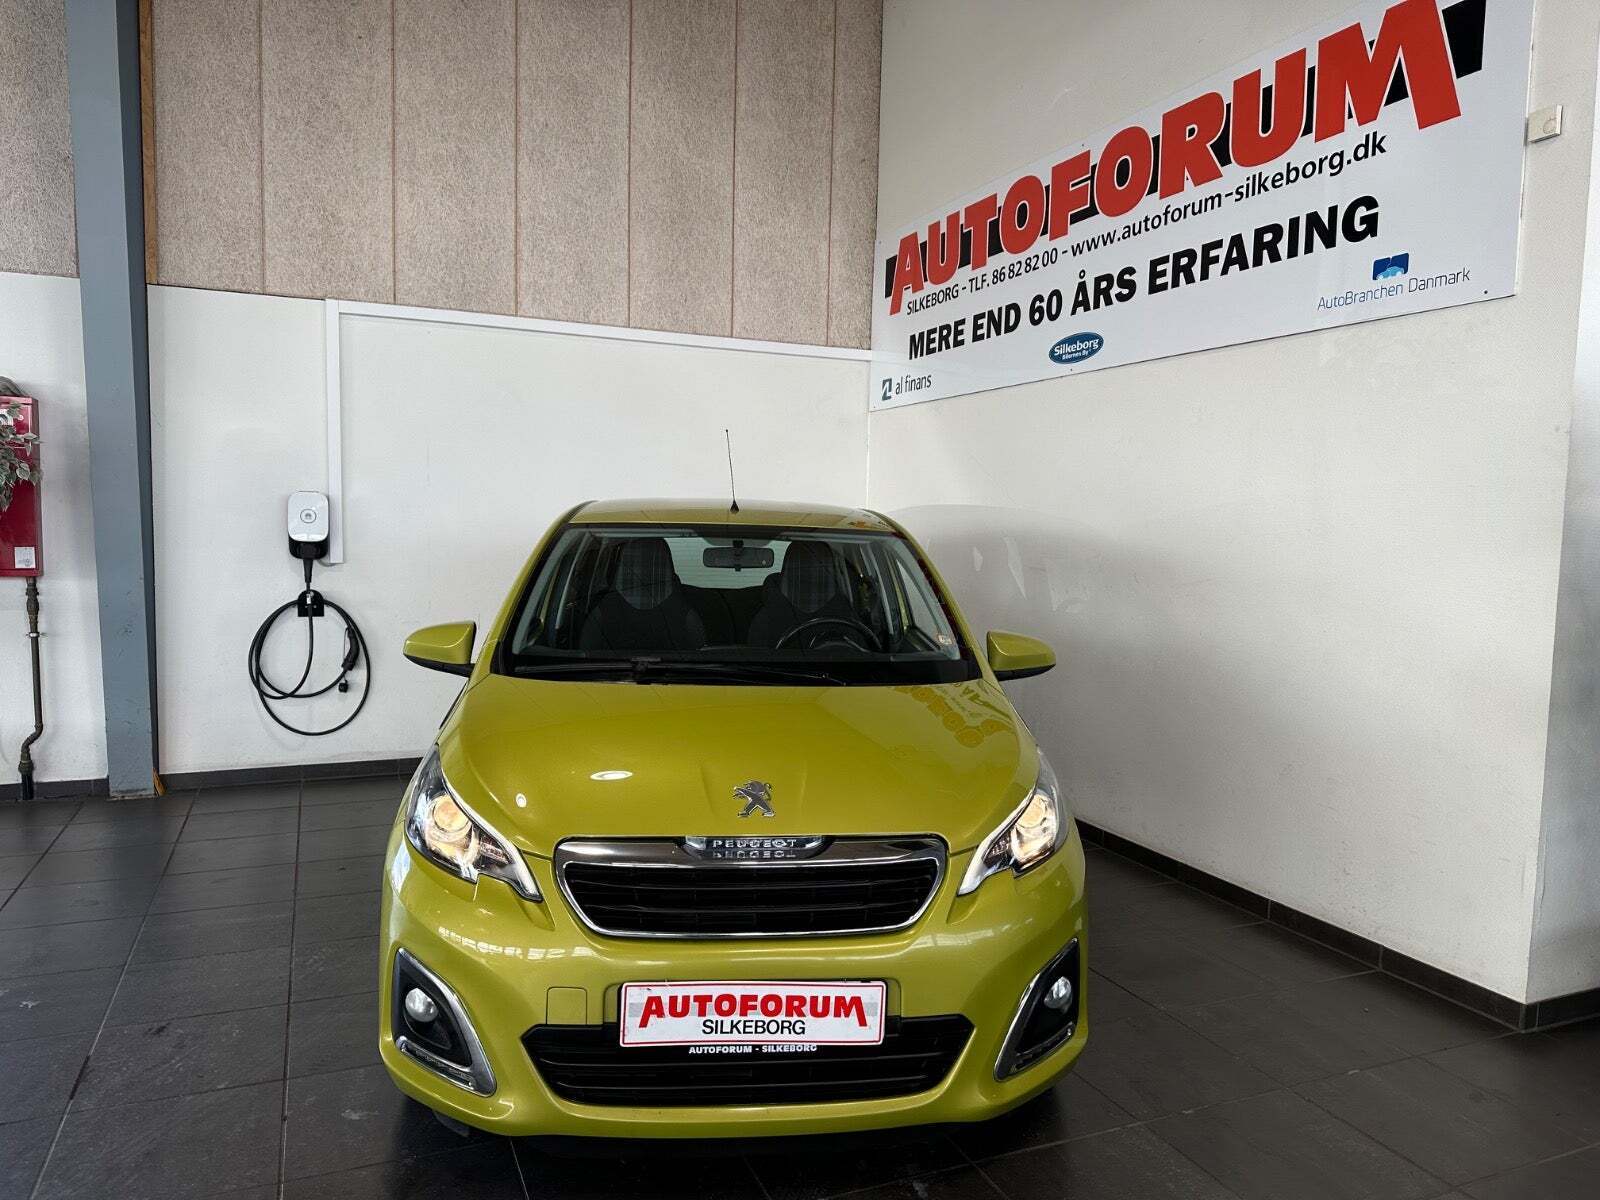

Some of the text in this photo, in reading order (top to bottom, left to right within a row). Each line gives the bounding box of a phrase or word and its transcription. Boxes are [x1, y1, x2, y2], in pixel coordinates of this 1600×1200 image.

[889, 0, 1461, 315] AUTOFORUM
[906, 284, 959, 315] SILKEBORG
[968, 273, 990, 294] TLF.
[1071, 131, 1387, 256] www.autoforum-silkeborg.dk
[909, 195, 1379, 360] MERE END 60 ÅRS ERFARING
[1317, 267, 1470, 311] AutoBranchen Danmark
[1054, 339, 1099, 356] Silkeborg
[895, 374, 932, 395] al finans
[712, 839, 797, 848] PEUGEOT
[639, 994, 868, 1028] AUTOFORUM
[702, 1019, 806, 1035] SILKEBORG
[688, 1045, 752, 1054] AUTOFORUM
[762, 1044, 817, 1053] SILKEBORG
